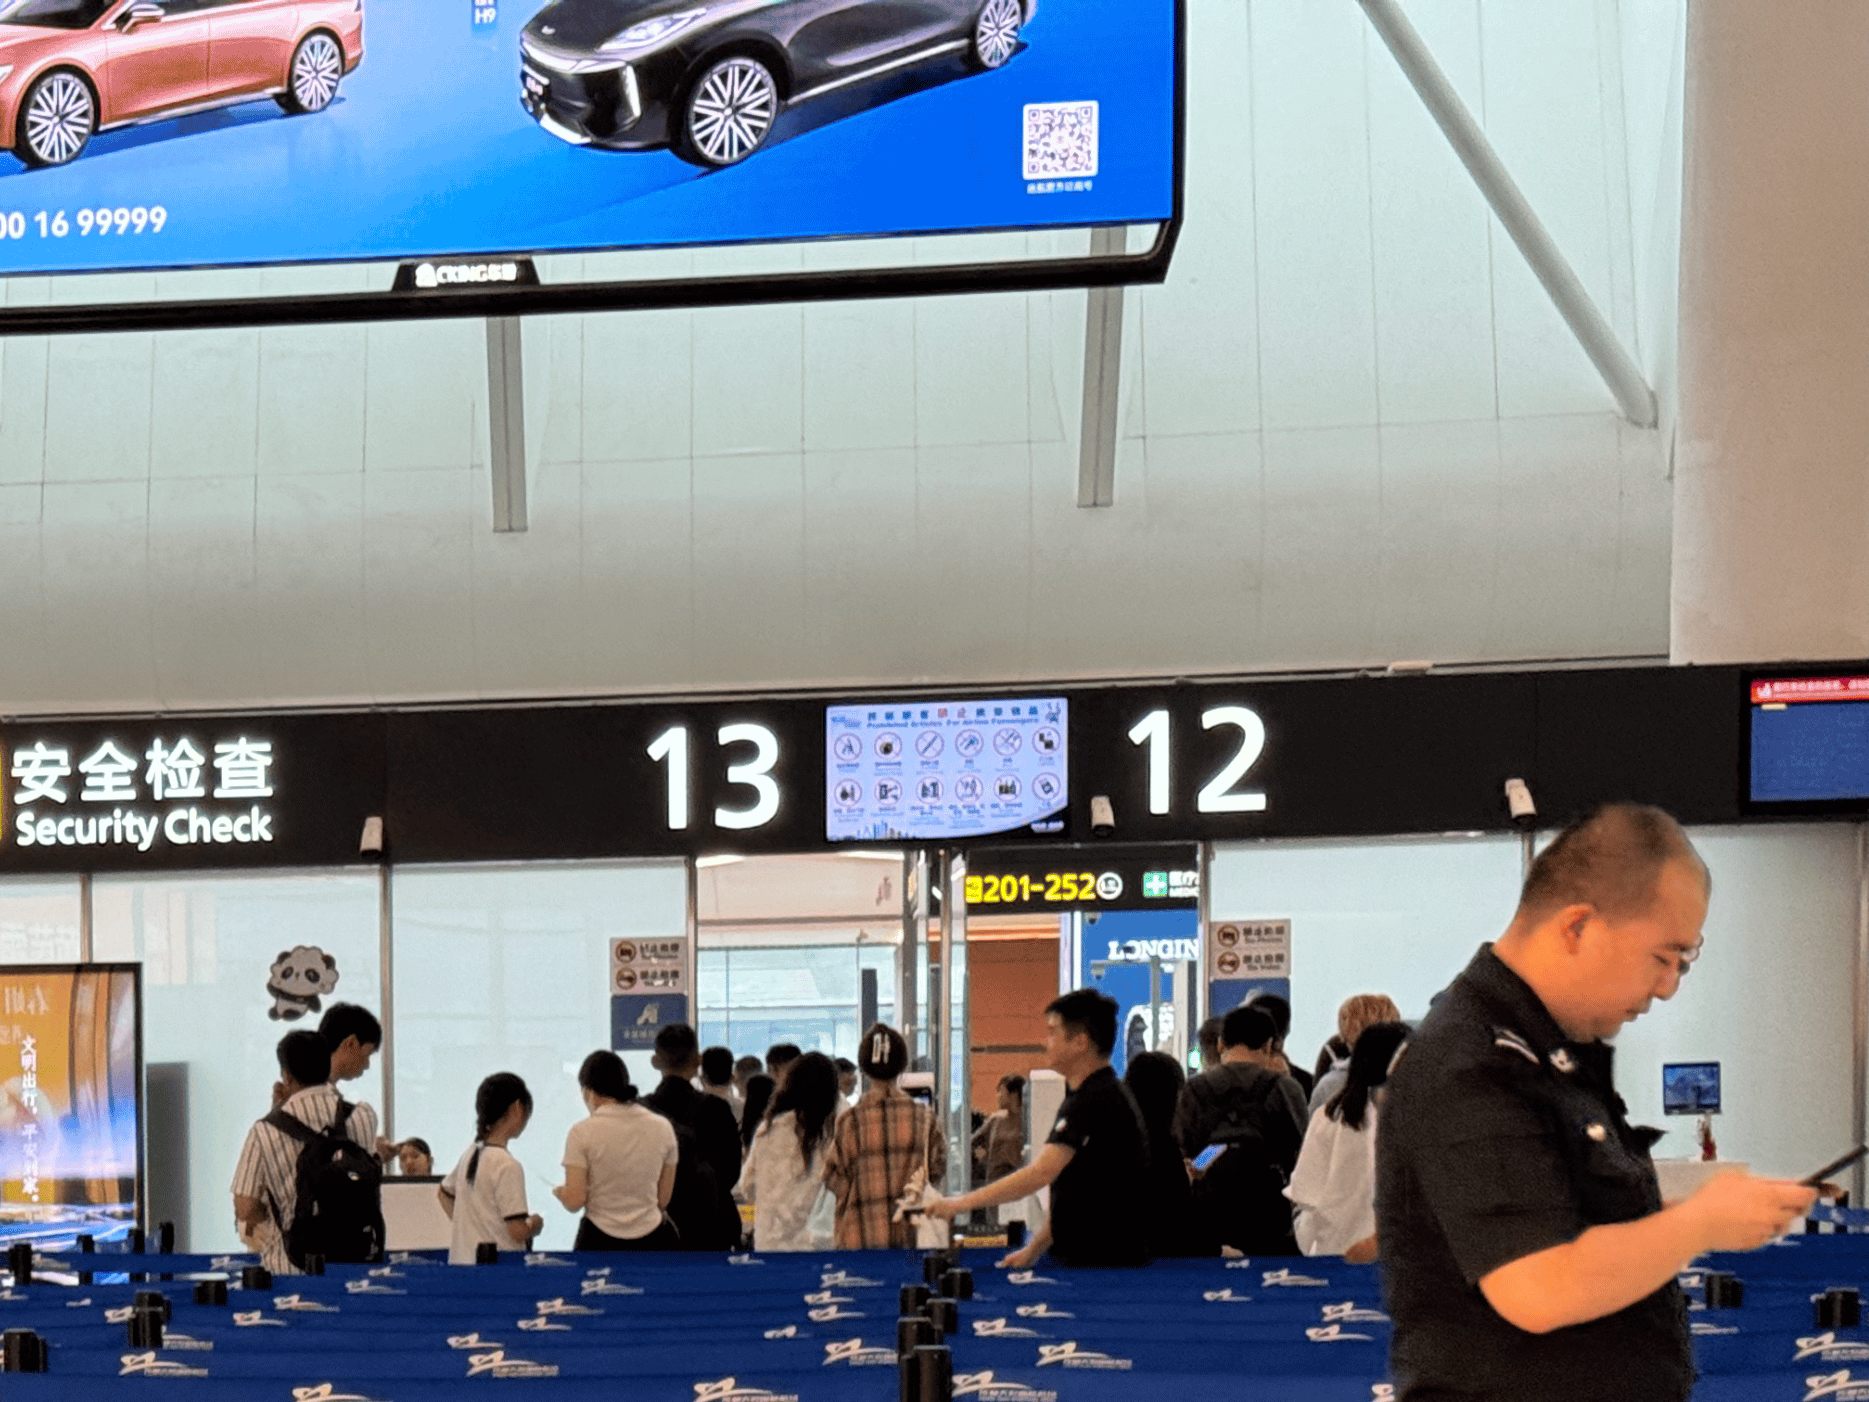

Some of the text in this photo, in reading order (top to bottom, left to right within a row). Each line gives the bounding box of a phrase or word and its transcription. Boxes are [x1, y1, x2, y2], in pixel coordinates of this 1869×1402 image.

[34, 210, 69, 238] 16
[76, 206, 167, 236] 99999
[11, 738, 274, 804] 安全检查
[646, 724, 780, 829] 13
[1128, 706, 1267, 815] 12
[16, 807, 274, 852] Security Check
[983, 872, 1096, 902] 201-252
